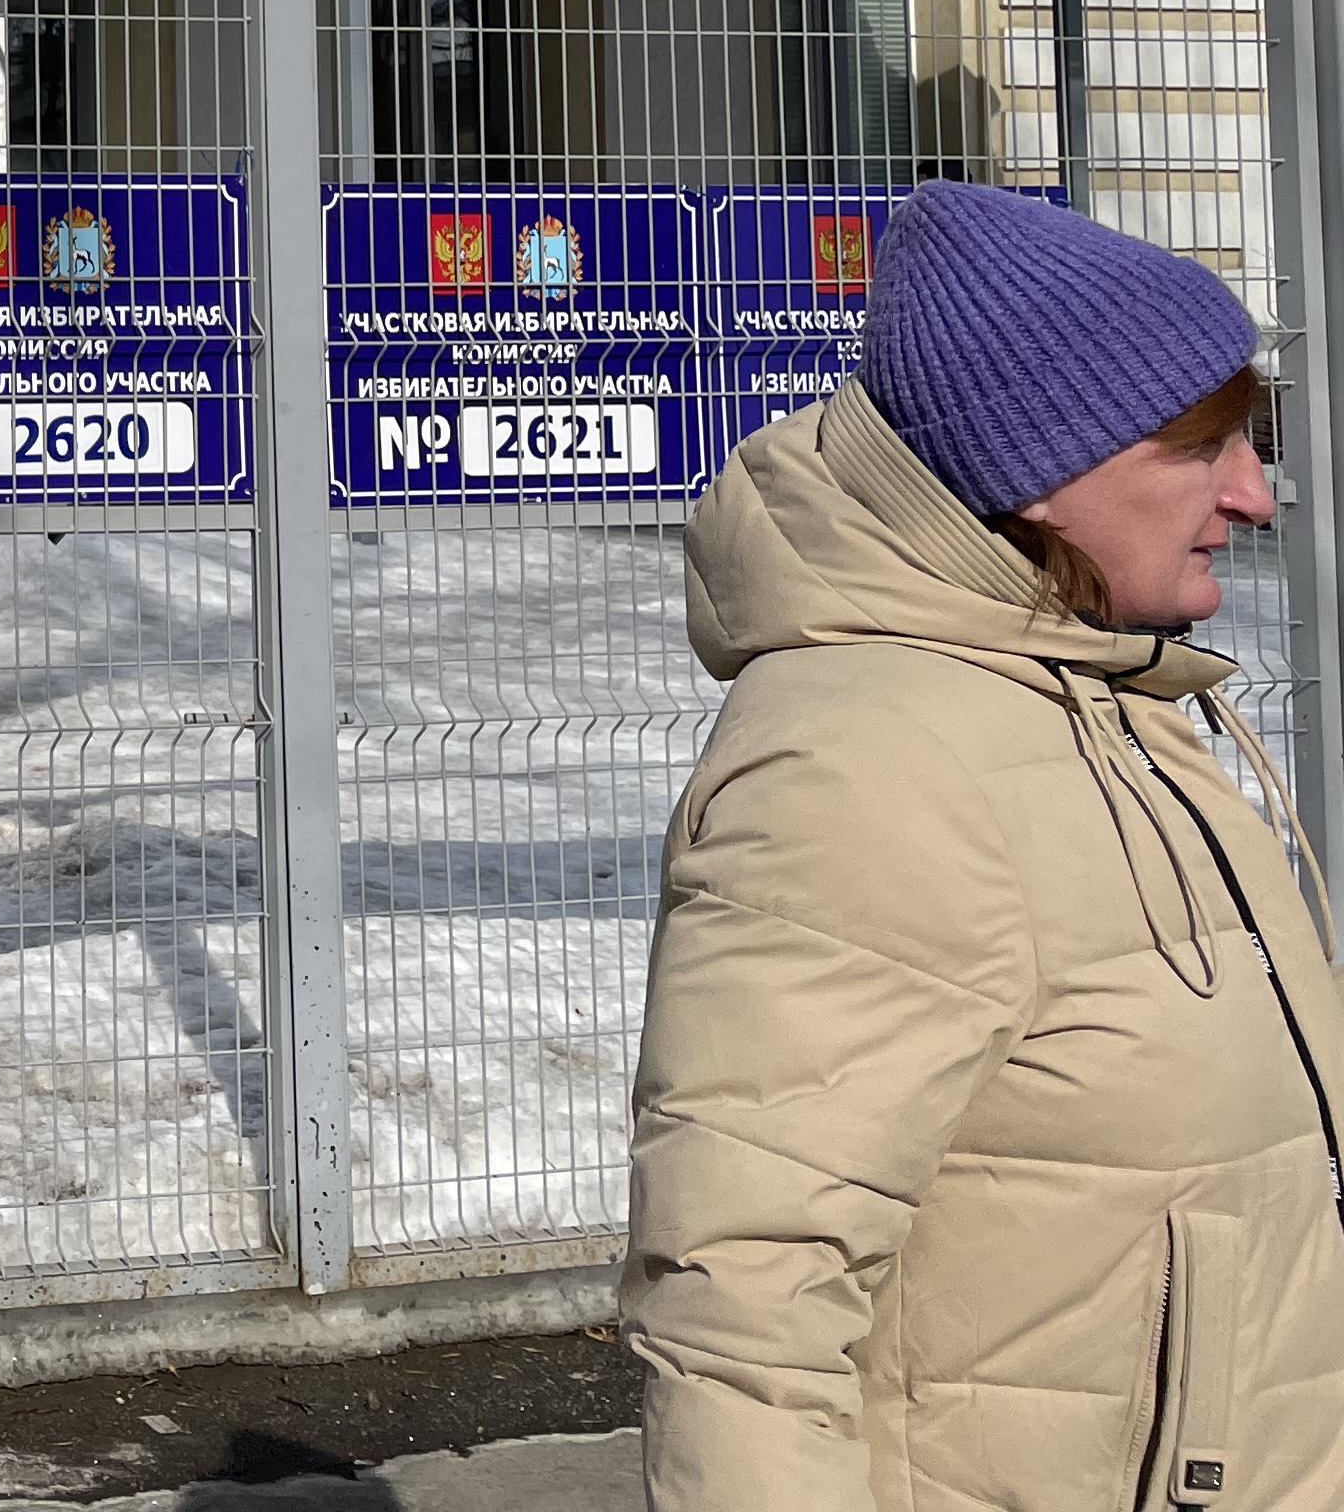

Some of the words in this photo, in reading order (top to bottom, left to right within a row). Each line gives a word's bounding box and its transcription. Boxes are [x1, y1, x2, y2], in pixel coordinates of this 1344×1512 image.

[20, 305, 223, 327] ИЗБИРАТЕЛЬНАЯ
[339, 312, 486, 334] УЧАСТКОВАЯ
[495, 311, 684, 333] ИЗБИРАТЕЛЬНАЯ
[452, 344, 577, 365] КОМИССИЯ
[105, 371, 211, 392] УЧАСТКА
[358, 376, 567, 398] ИЗБИРАТЕЛЬНОГО
[574, 375, 673, 396] УЧАСТКА
[12, 414, 150, 464] 2620
[379, 415, 451, 470] №
[495, 415, 623, 461] 2621
